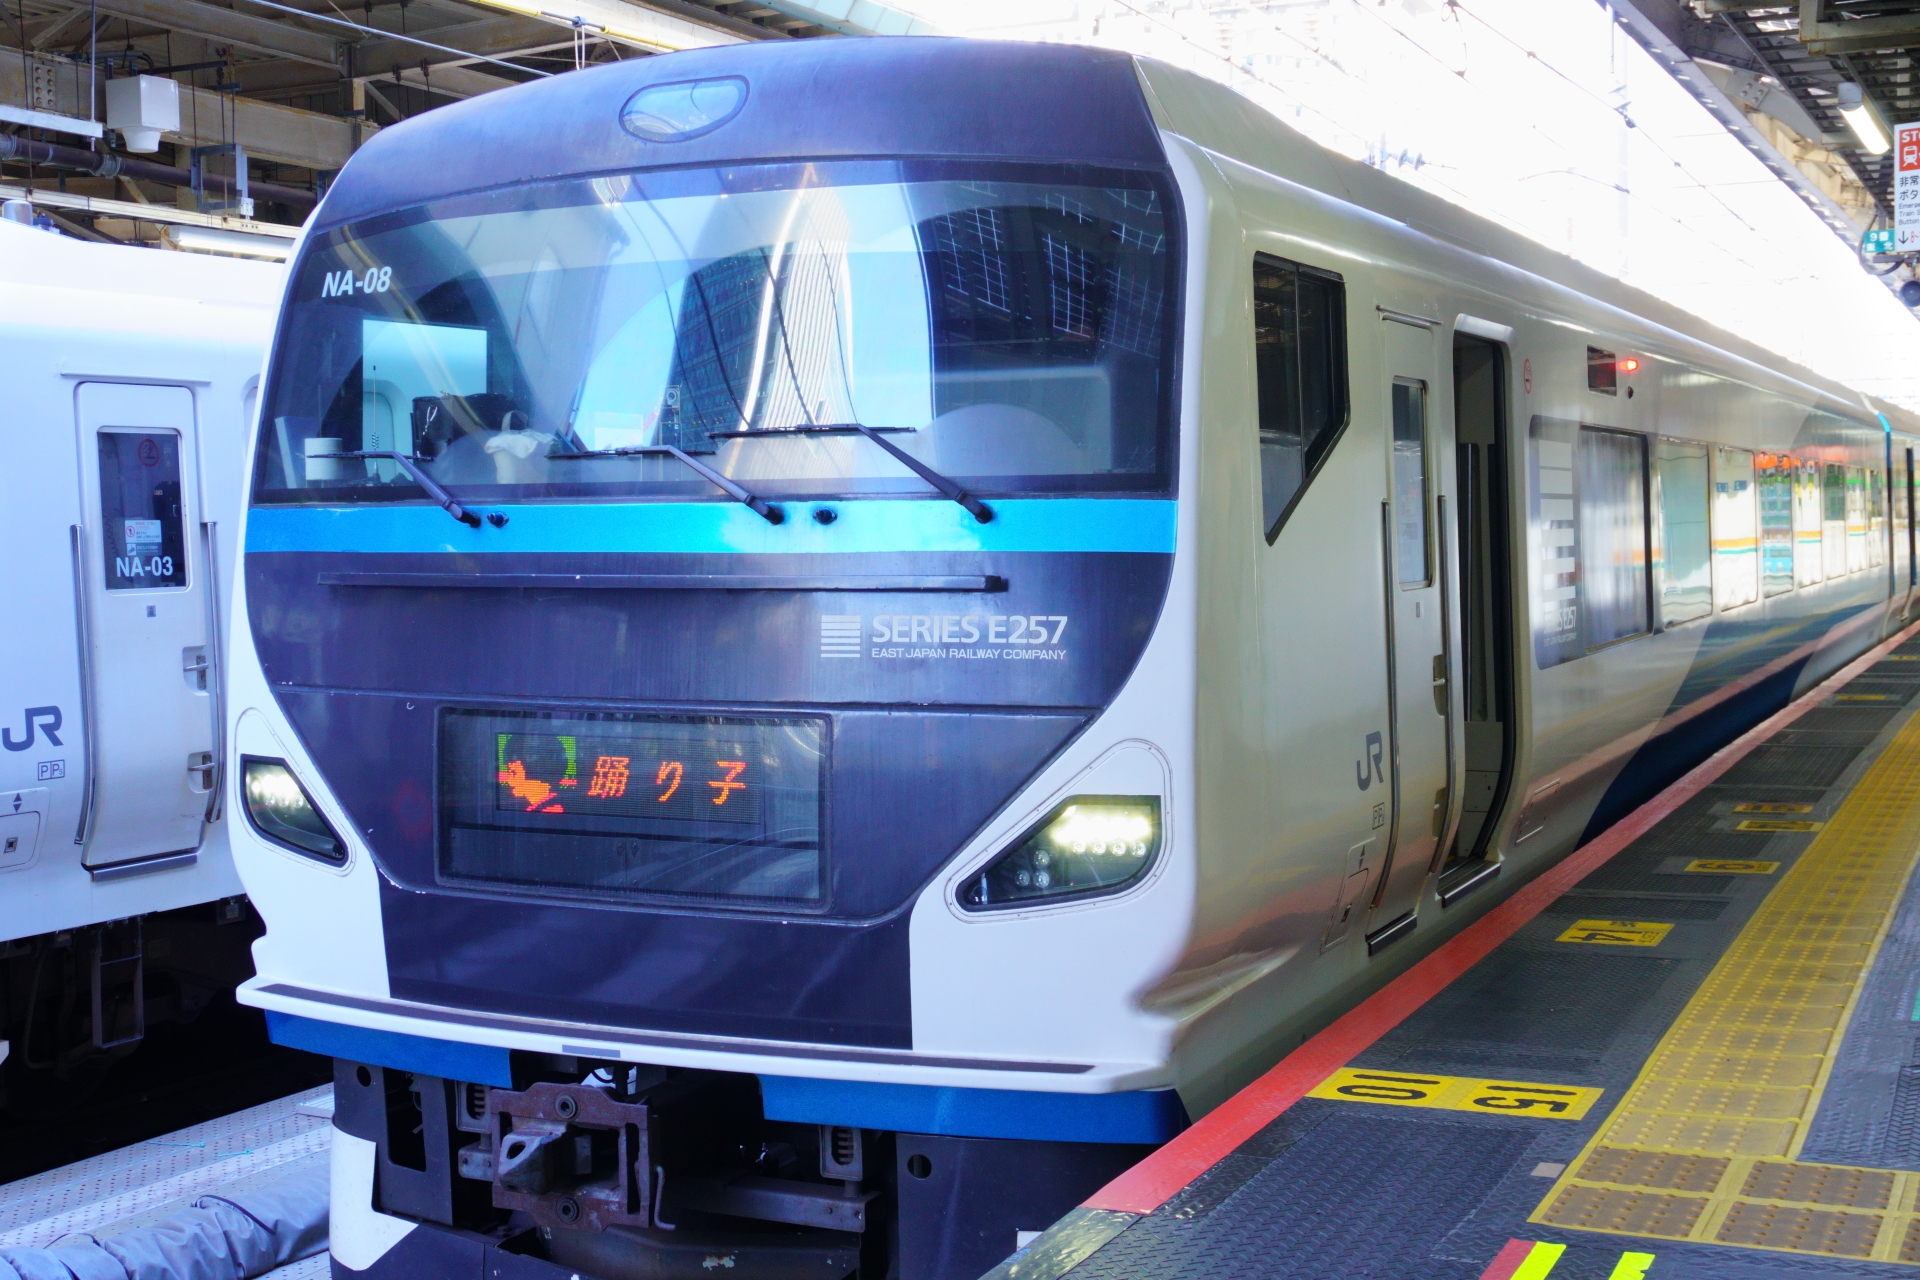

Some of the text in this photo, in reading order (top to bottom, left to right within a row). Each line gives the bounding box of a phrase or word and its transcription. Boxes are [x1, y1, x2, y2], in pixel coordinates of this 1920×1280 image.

[1902, 130, 1920, 143] ST
[321, 265, 392, 298] NA-08
[116, 556, 173, 578] NA-03
[872, 615, 1068, 644] SERIES E257
[872, 648, 1067, 660] EAST JAPAN RAILWAY COMPANY
[2, 705, 64, 752] JR
[1356, 730, 1385, 791] JR
[587, 756, 746, 804] 踊り子
[1336, 1073, 1441, 1101] 10
[1472, 1085, 1578, 1113] 15
